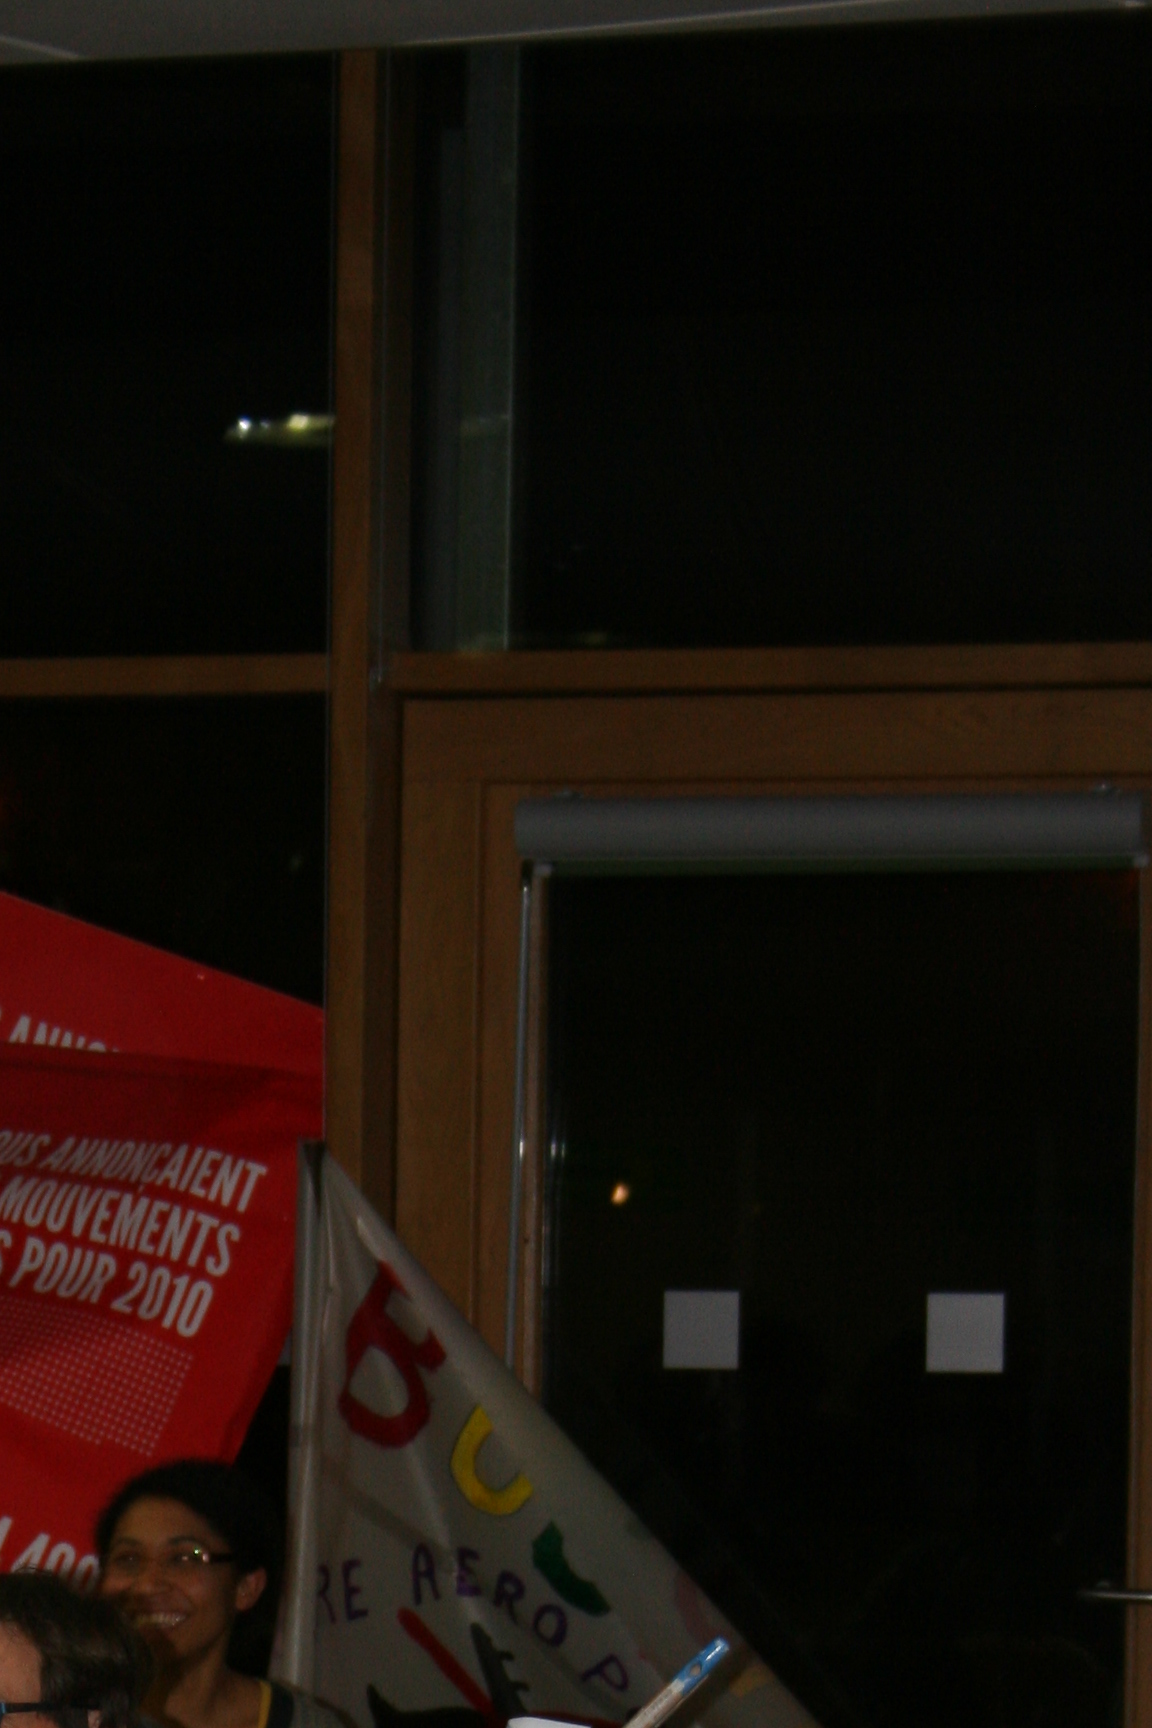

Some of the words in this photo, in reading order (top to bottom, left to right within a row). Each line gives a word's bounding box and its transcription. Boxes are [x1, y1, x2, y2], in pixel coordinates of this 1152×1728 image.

[38, 1135, 269, 1214] ANNONÇAIENT
[6, 1233, 118, 1305] POUR
[109, 1260, 215, 1338] 2010
